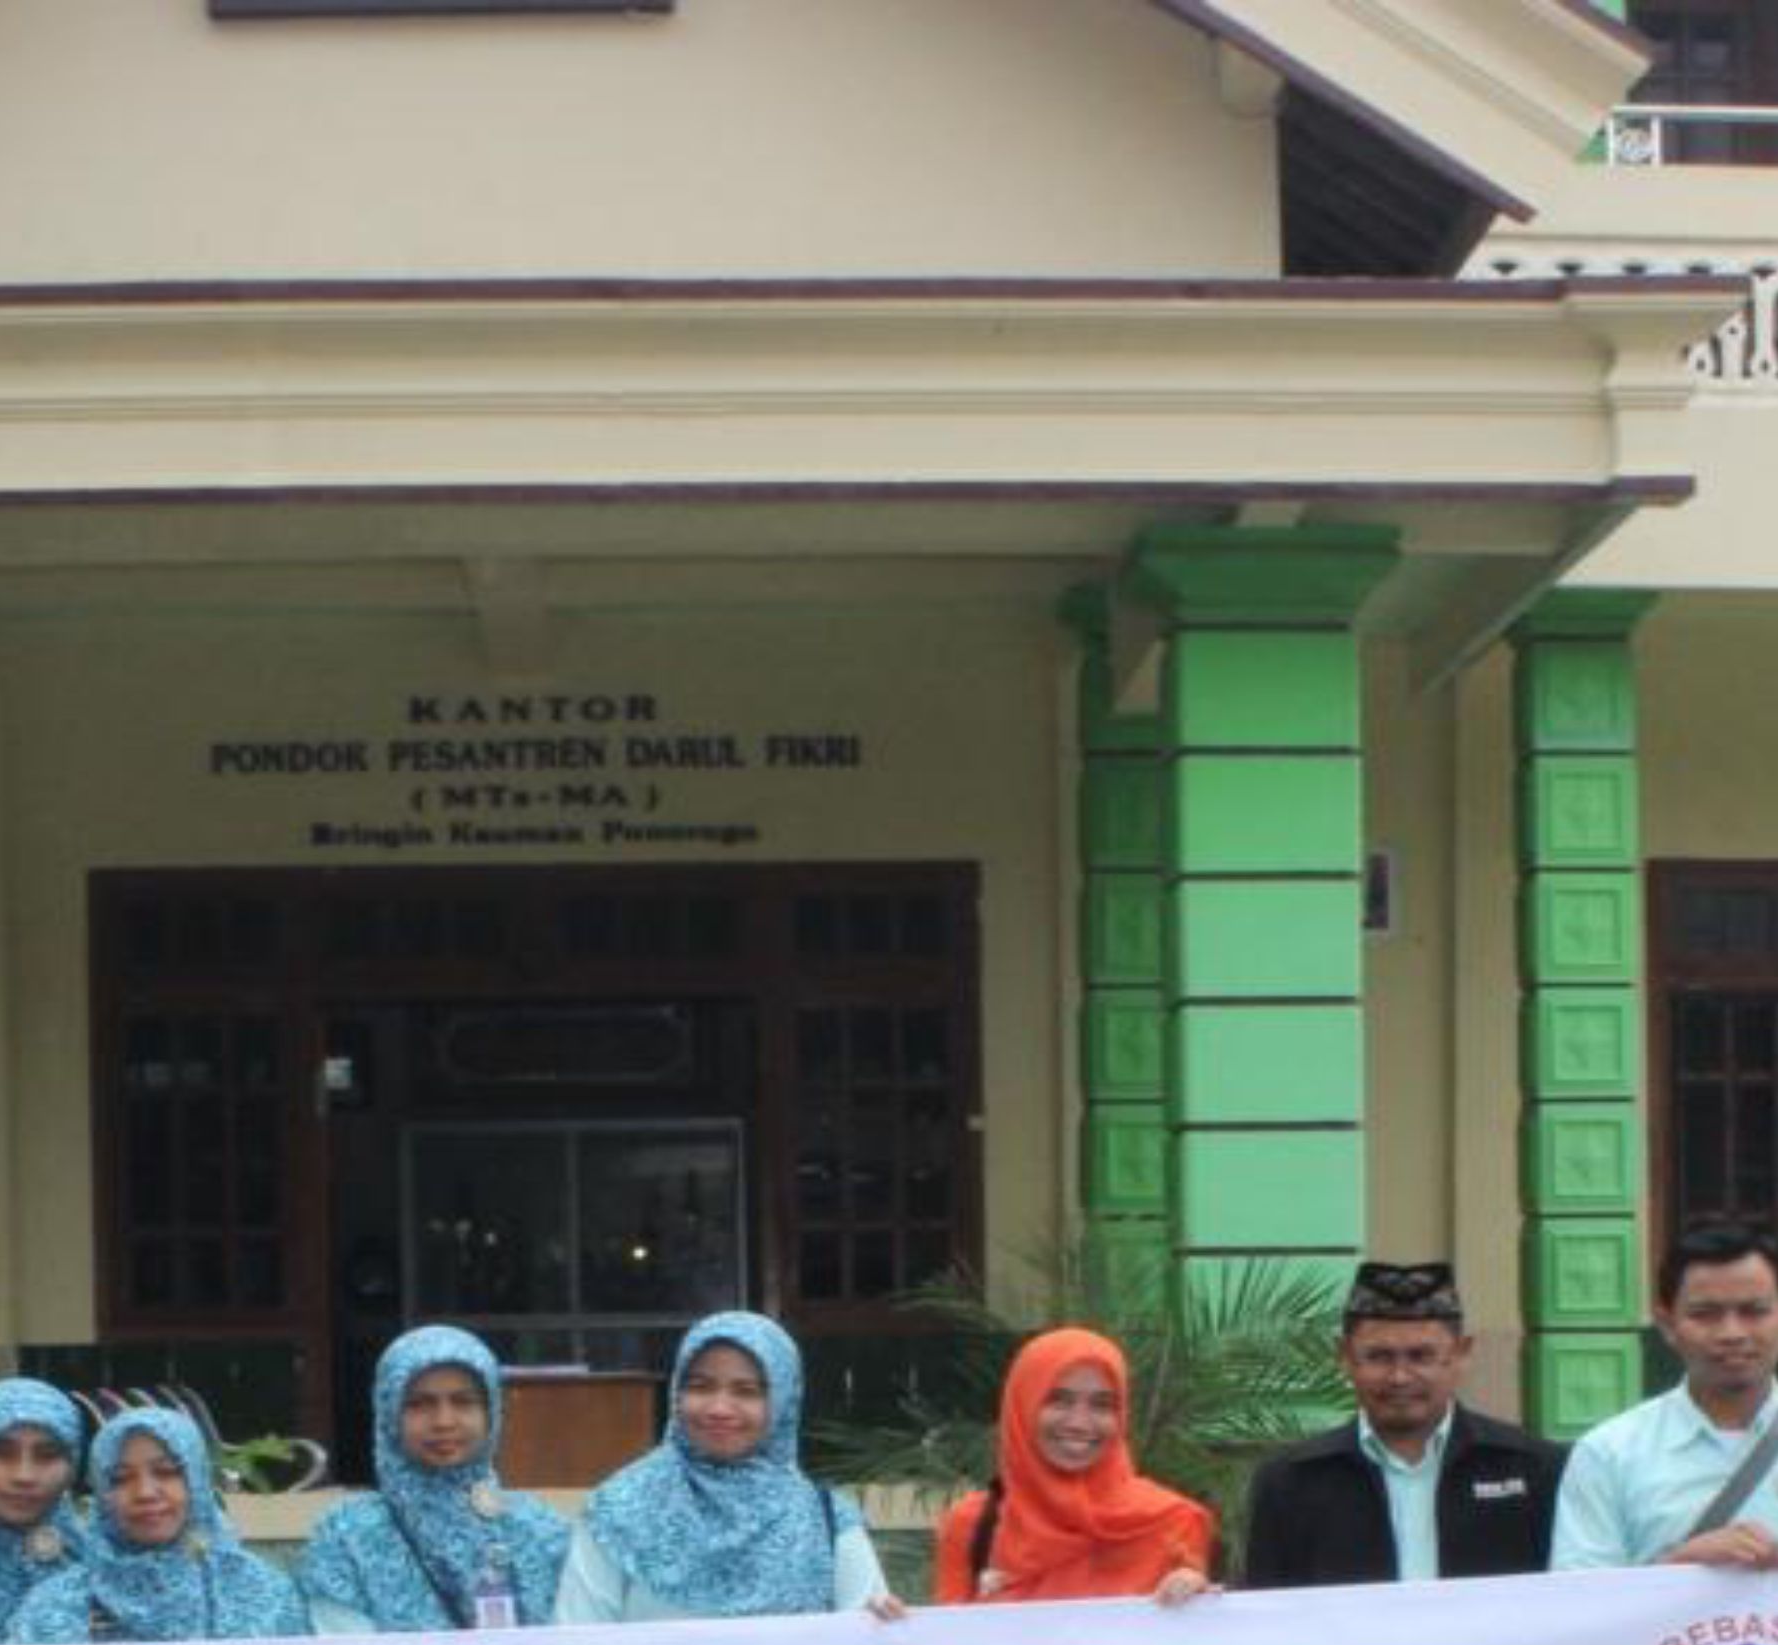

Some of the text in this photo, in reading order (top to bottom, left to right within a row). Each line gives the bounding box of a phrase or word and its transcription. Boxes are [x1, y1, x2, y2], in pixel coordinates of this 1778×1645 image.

[407, 695, 657, 724] KANTOR
[211, 735, 861, 774] PONDOK PESANTREN DARUL FIKRI
[311, 822, 433, 848] Bringin
